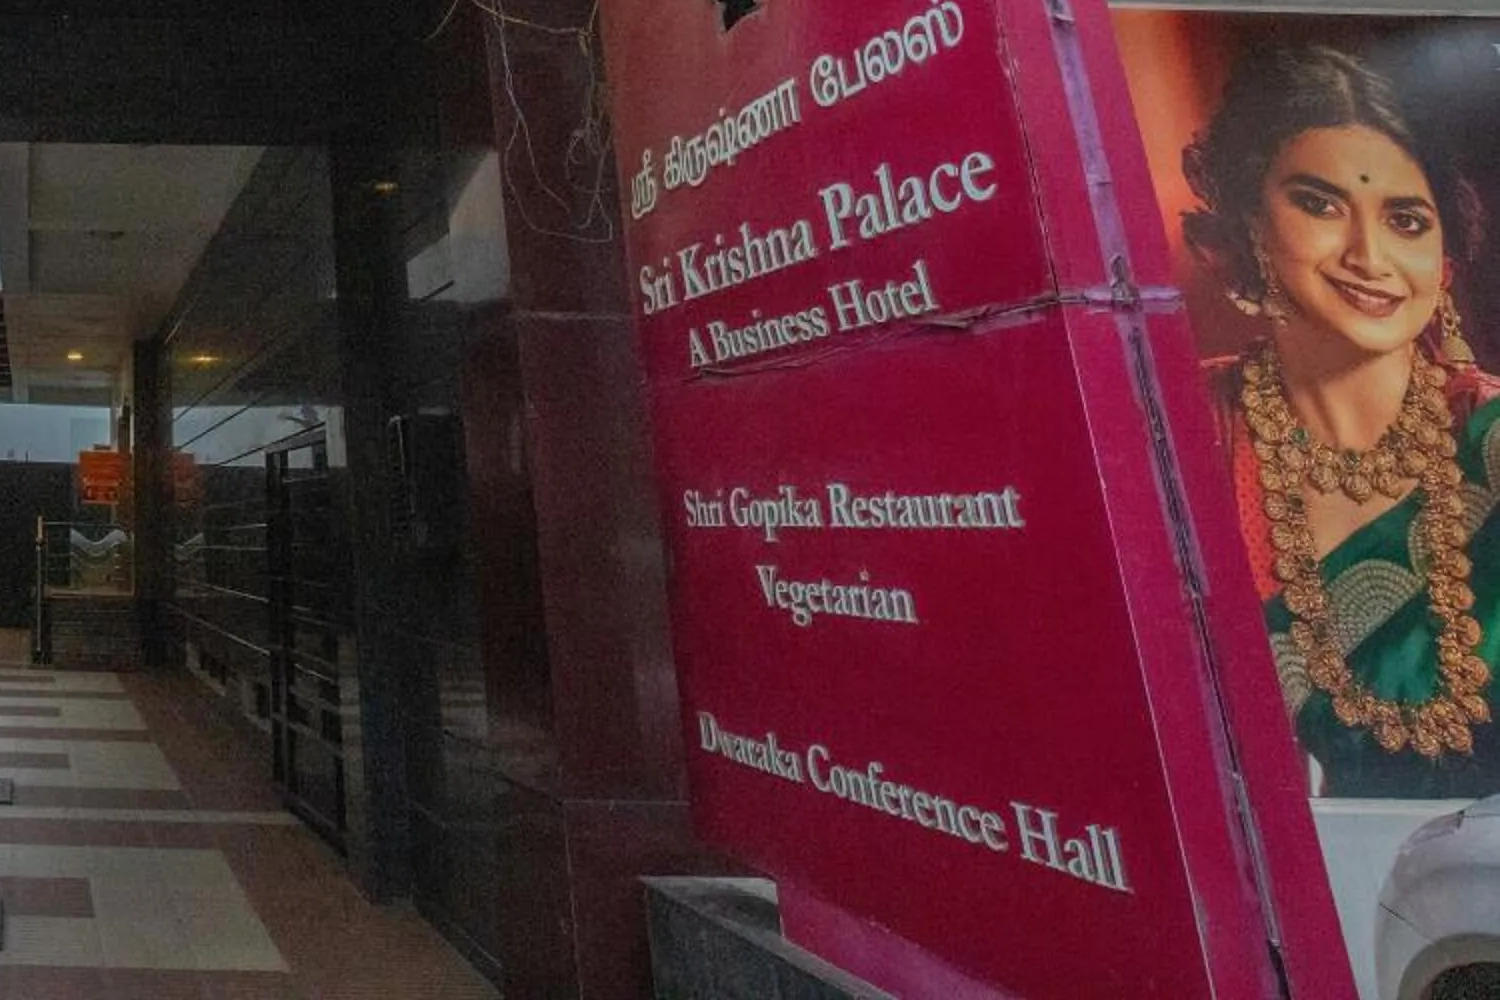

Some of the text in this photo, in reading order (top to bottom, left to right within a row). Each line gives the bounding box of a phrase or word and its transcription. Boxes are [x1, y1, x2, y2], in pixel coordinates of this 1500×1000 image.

[663, 77, 801, 187] கிருஷ்ணா
[639, 151, 997, 315] Sri Krishna Palace
[688, 259, 940, 368] A Business Hotel
[683, 482, 1026, 542] Shri Gopika Restaurant
[755, 565, 919, 627] Vegetarian
[699, 711, 1136, 895] Dwaraka Conference Hall
